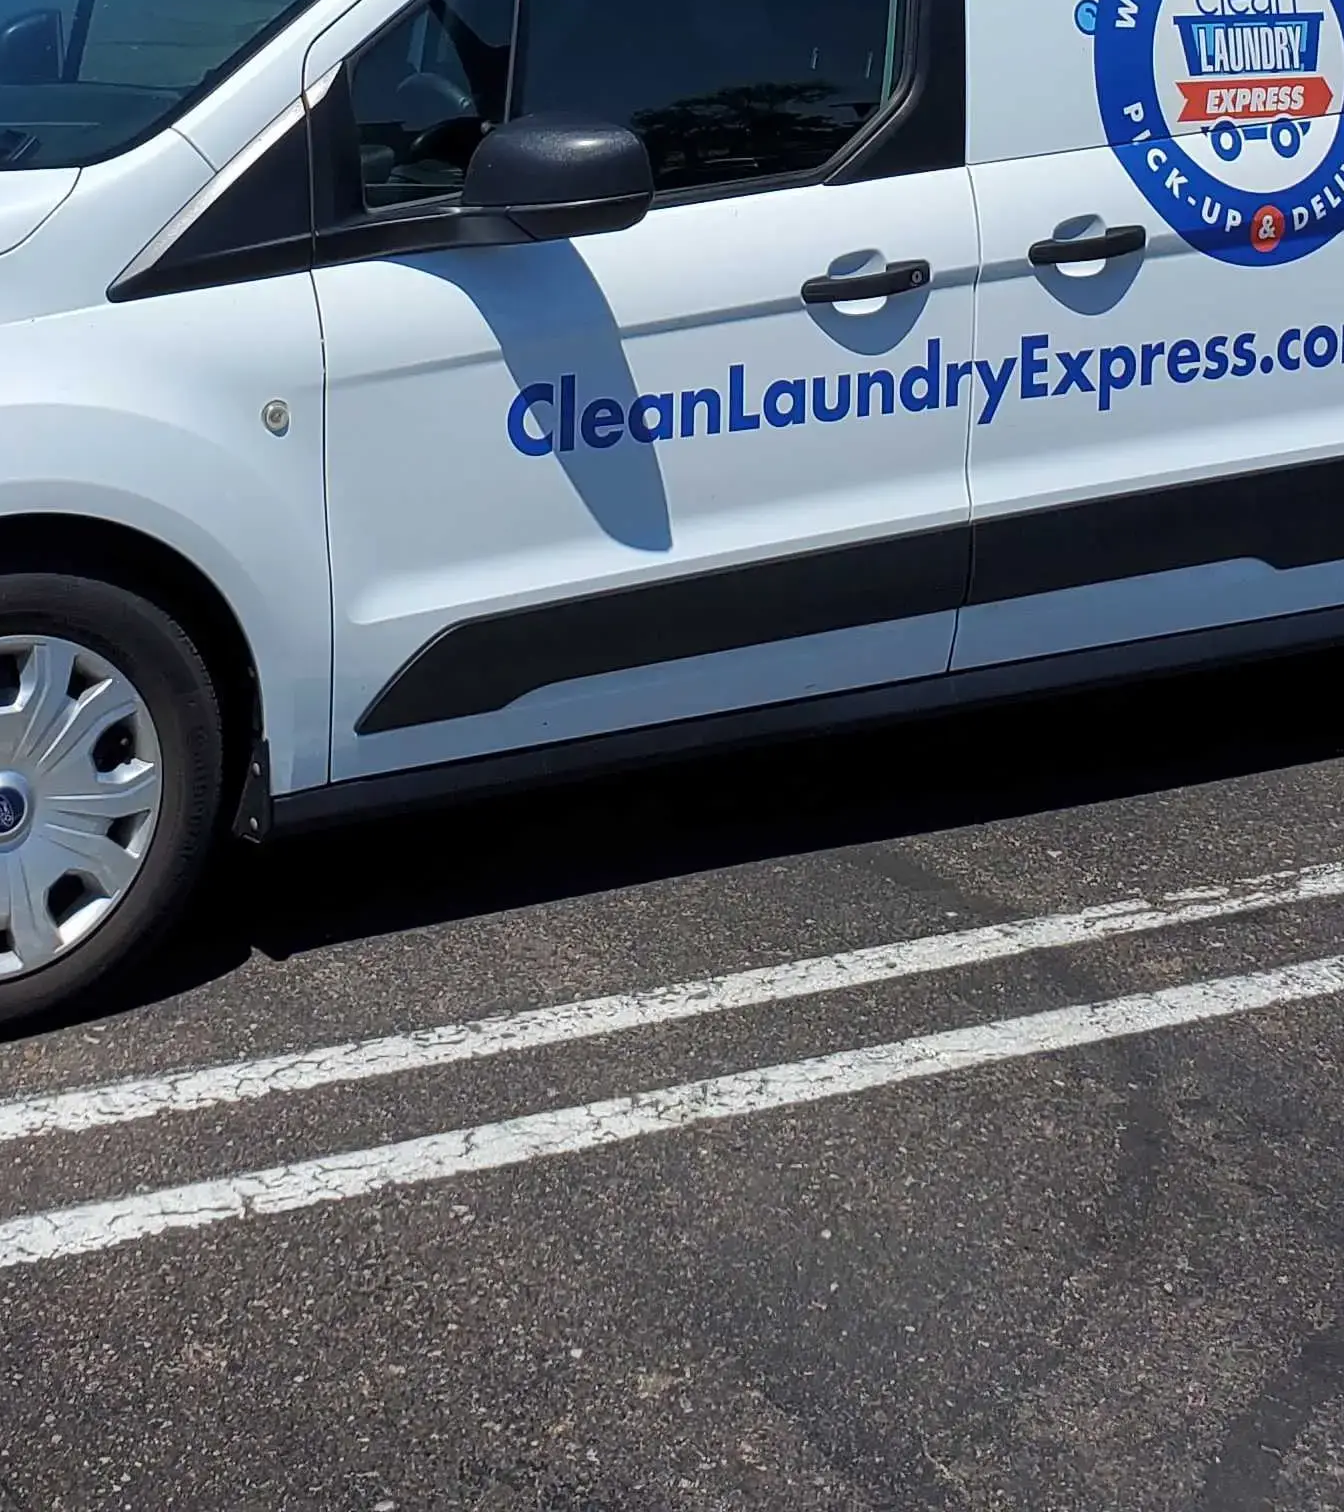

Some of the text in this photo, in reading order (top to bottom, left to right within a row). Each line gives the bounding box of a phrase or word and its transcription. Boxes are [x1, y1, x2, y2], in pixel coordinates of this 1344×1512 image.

[1197, 25, 1303, 72] LAUNDRY
[1206, 85, 1305, 115] EXPRESS
[1123, 101, 1242, 232] PICK-UP
[1258, 215, 1276, 240] &
